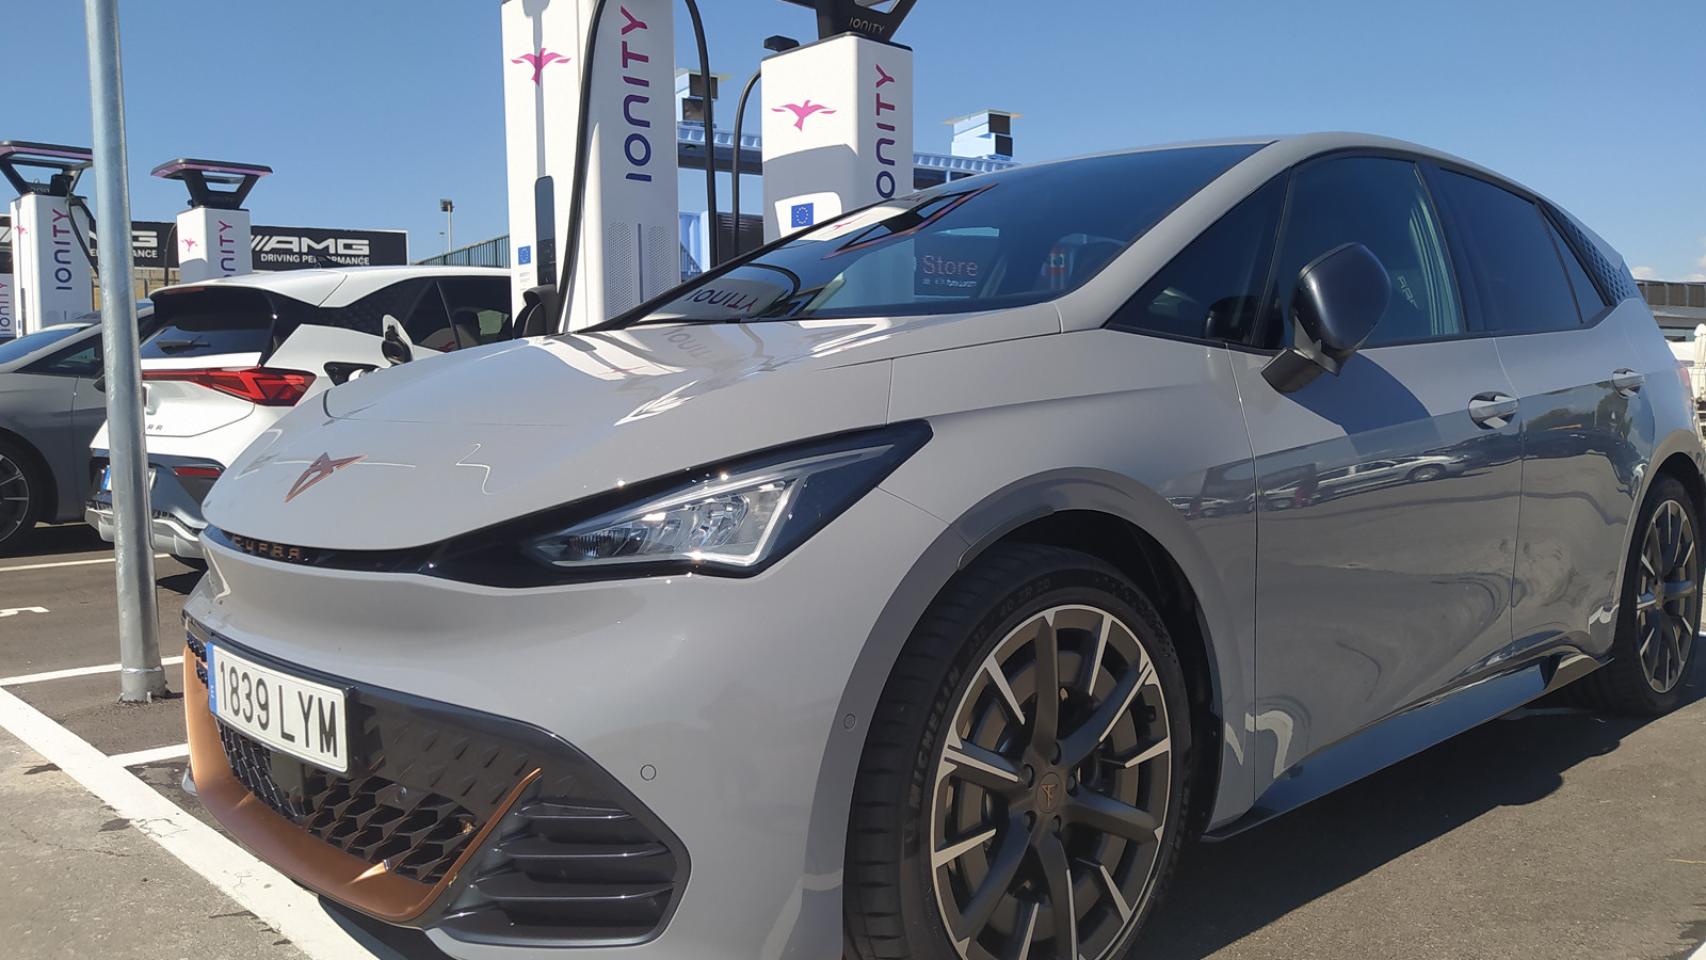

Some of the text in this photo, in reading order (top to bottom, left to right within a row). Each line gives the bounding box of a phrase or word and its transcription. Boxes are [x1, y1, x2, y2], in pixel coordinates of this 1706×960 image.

[849, 16, 885, 33] IONITY
[620, 6, 652, 182] IONITY
[875, 63, 896, 199] ONITY
[52, 208, 73, 291] IONITY
[260, 253, 301, 264] DRIVING
[922, 255, 978, 276] Store
[220, 660, 338, 758] 1839 LYM
[907, 664, 960, 809] MICHELIN
